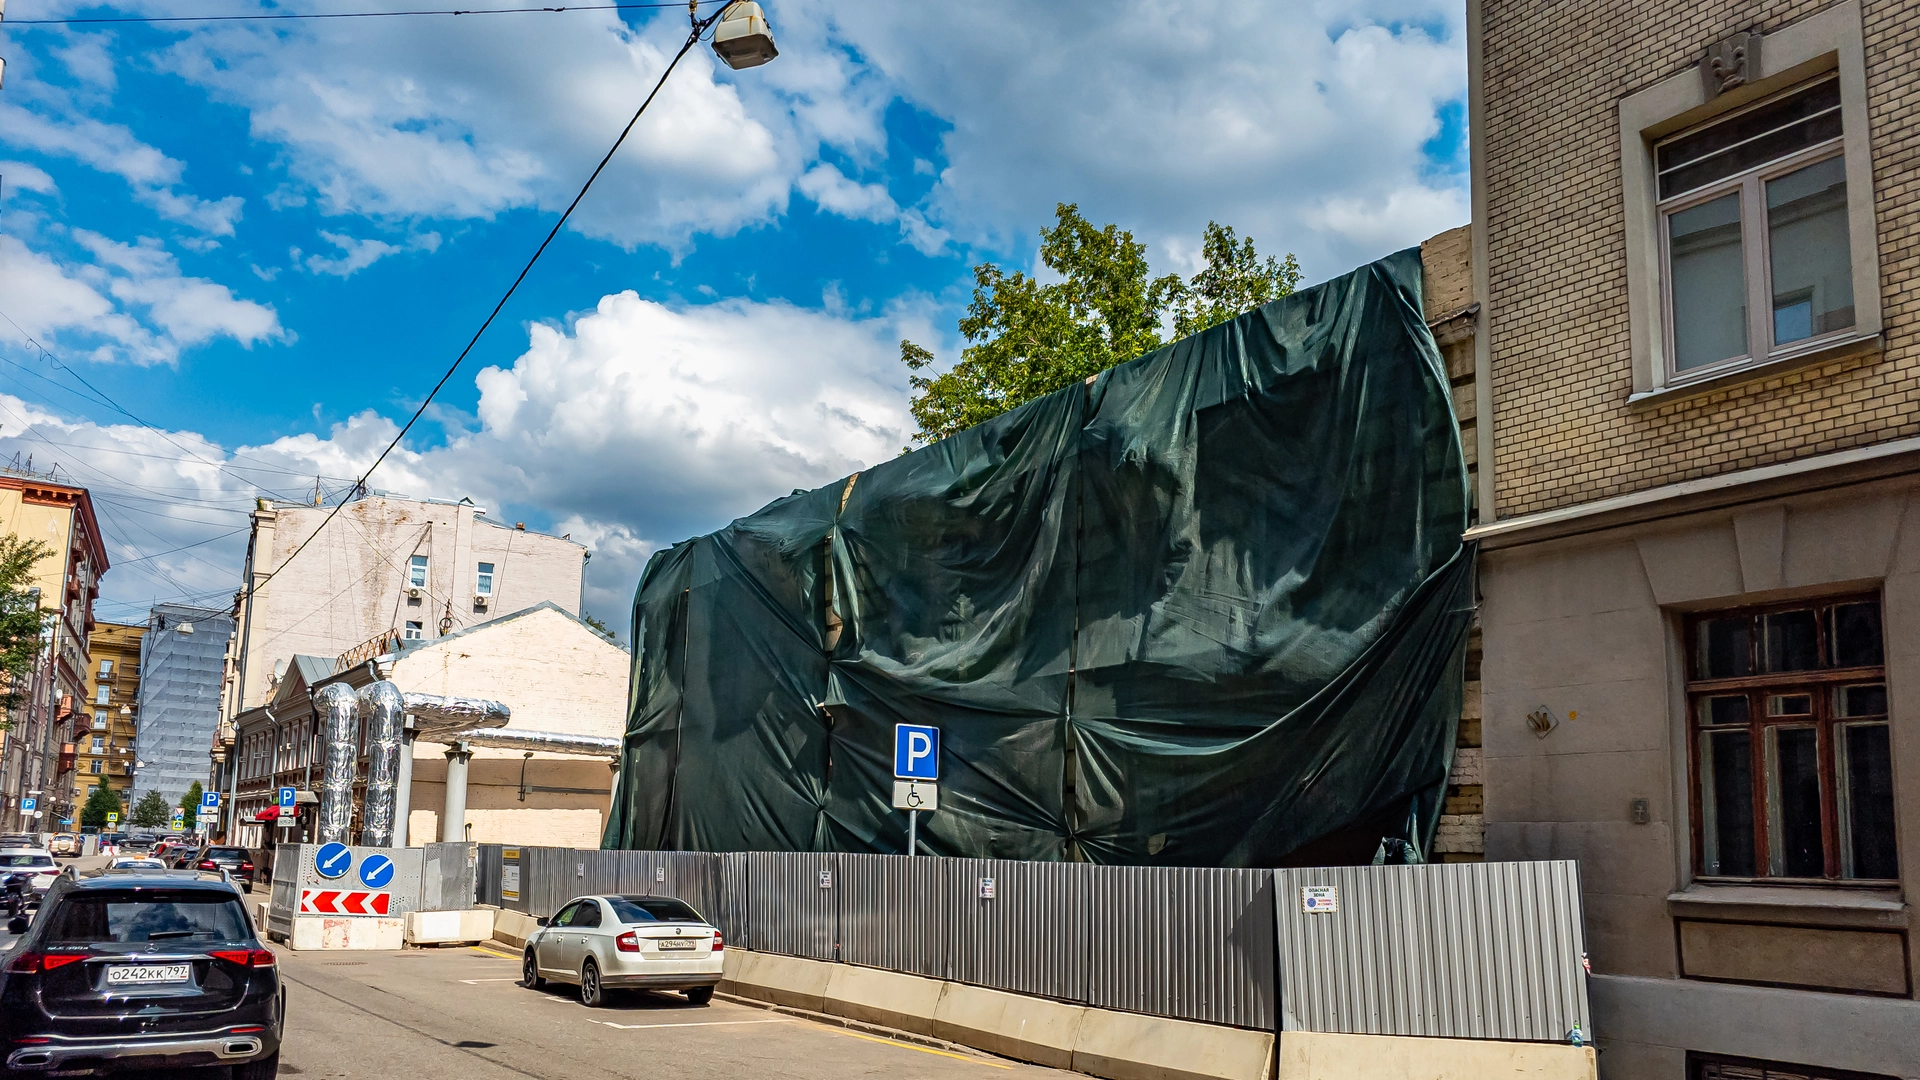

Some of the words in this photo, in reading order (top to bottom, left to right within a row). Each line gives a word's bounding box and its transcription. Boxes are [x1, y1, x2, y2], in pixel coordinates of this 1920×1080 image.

[908, 731, 931, 772] P
[206, 793, 216, 805] P
[283, 790, 292, 804] P
[25, 800, 33, 808] P
[167, 966, 186, 976] 797
